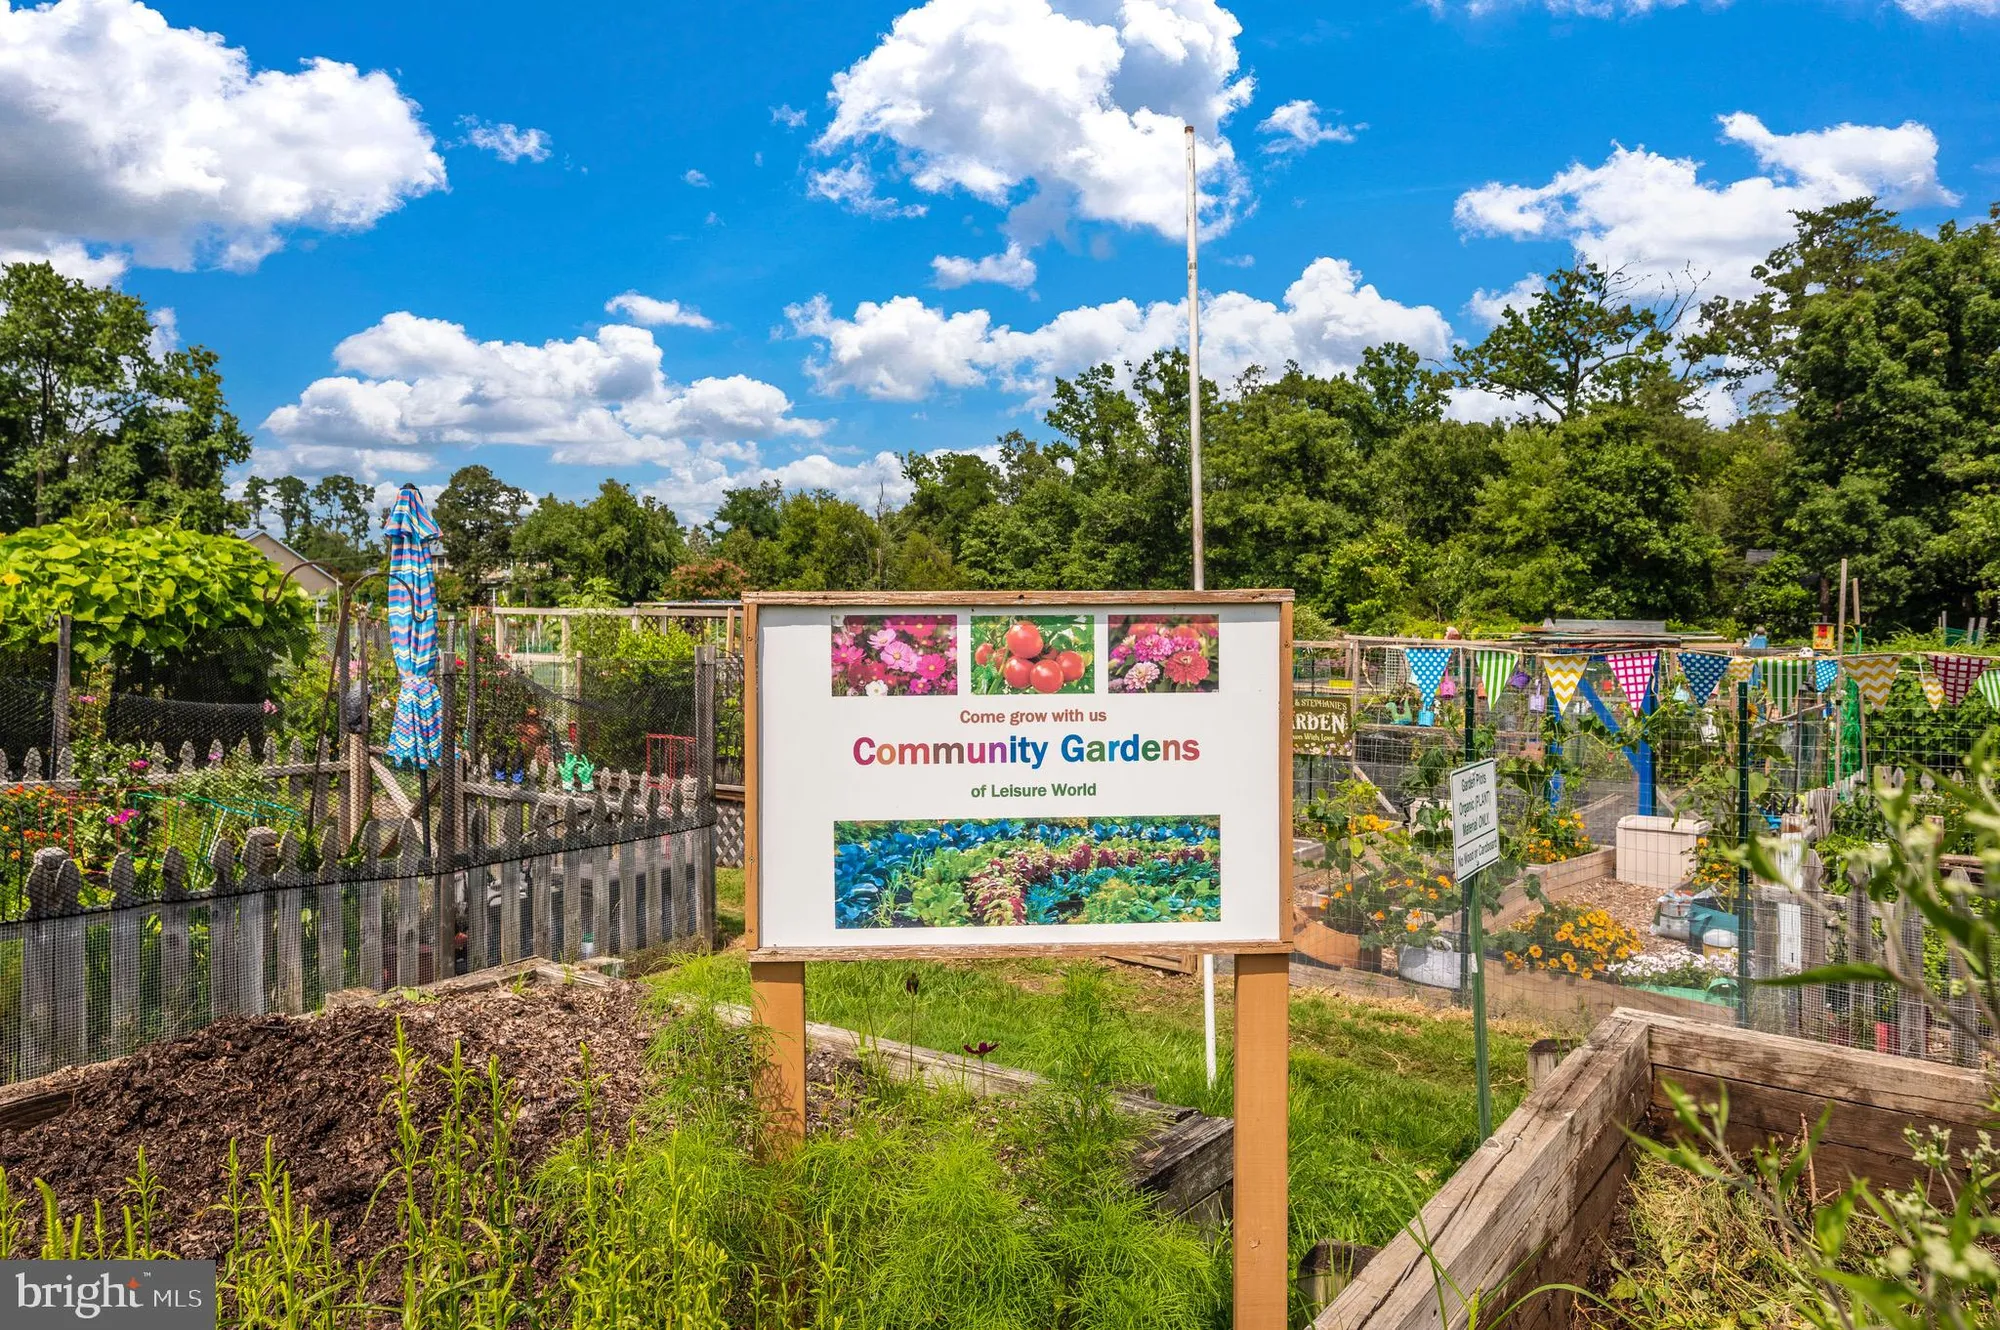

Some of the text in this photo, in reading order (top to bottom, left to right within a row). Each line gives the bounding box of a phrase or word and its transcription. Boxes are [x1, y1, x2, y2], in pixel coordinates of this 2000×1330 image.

[1301, 698, 1347, 710] STEPHANIE'S
[959, 708, 1107, 726] Come grow with us
[1292, 711, 1348, 734] RDEN
[852, 733, 1201, 770] Community Gardens
[1475, 773, 1487, 786] Plots
[970, 782, 1097, 798] of Leisure World
[1459, 799, 1475, 817] Organic
[1462, 818, 1478, 837] Material
[1457, 853, 1464, 867] No
[1464, 849, 1475, 864] Wood
[1478, 838, 1497, 857] Cardboard
